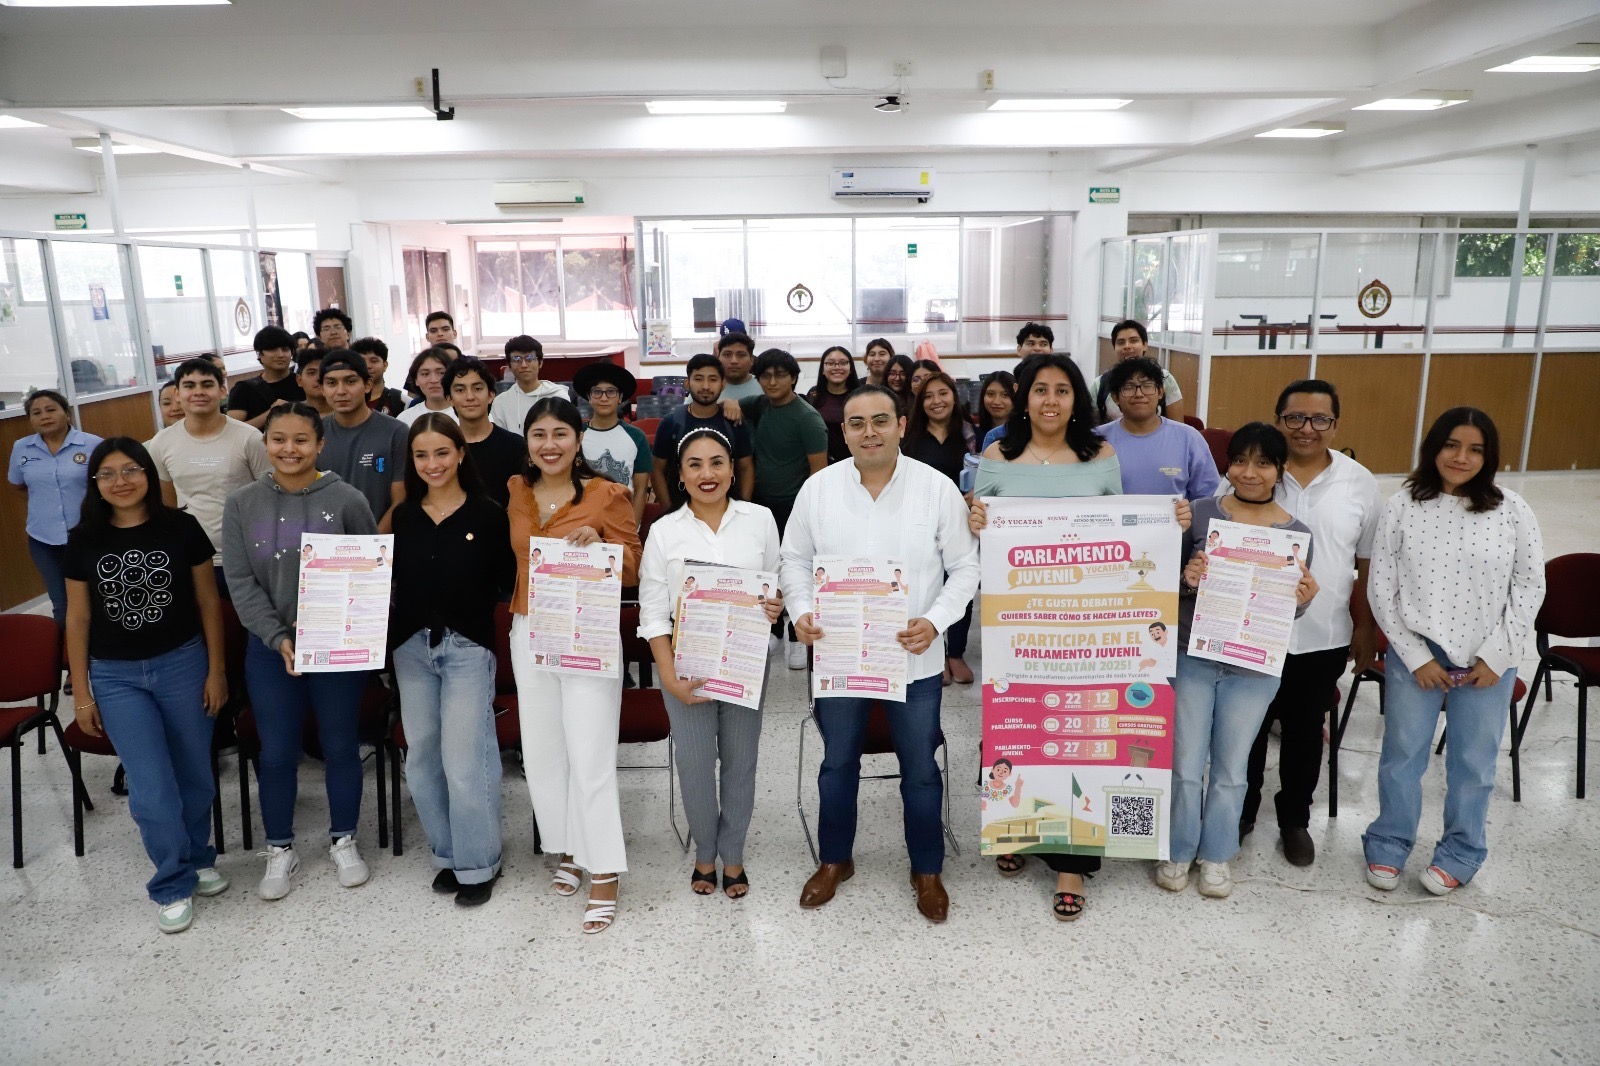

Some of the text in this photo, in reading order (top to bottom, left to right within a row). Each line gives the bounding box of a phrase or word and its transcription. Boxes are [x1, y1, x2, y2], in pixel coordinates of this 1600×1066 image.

[1014, 545, 1124, 566] PARLAMENTO
[1086, 562, 1124, 574] YUCATÁN
[1016, 568, 1077, 585] JUVENIL
[1026, 597, 1133, 609] ¿TE GUSTA DEBATIR Y
[1001, 612, 1032, 620] QUIERES
[1059, 612, 1080, 620] CÓMO
[1092, 612, 1116, 620] HACEN
[1133, 610, 1158, 618] LEYES?
[1011, 631, 1142, 648] ¡PARTICIPA EN EL
[1015, 647, 1142, 660] PARLAMENTO JUVENIL
[1024, 660, 1132, 672] DE YUCATÁN 2025!
[1065, 691, 1110, 704] 22 12
[1064, 716, 1109, 728] 20 18
[1064, 742, 1108, 753] 27 31
